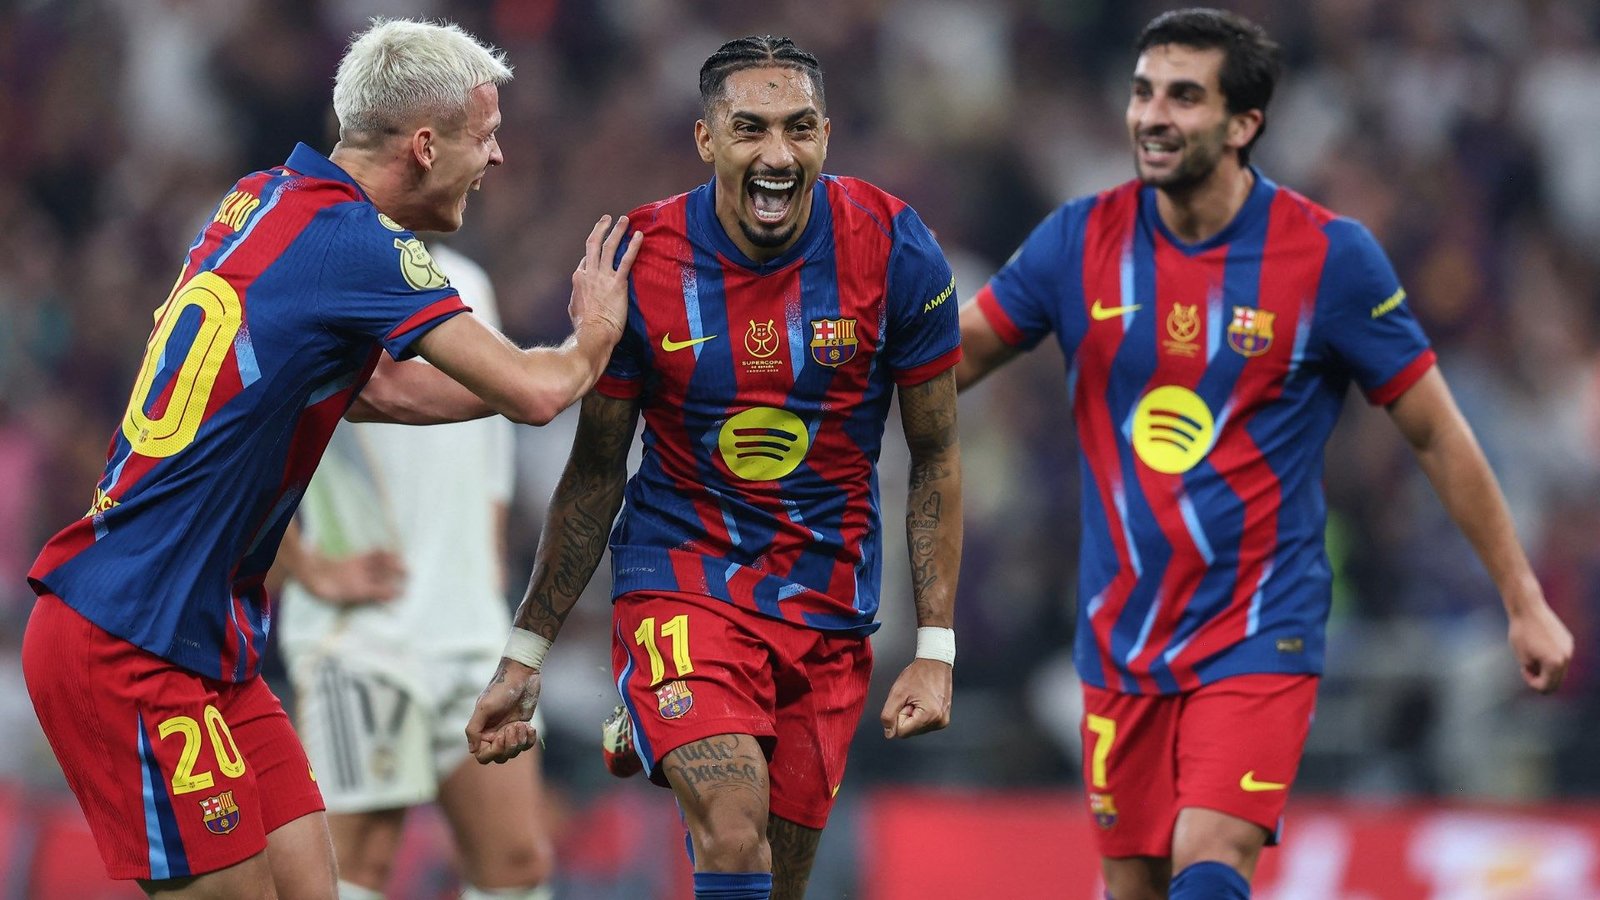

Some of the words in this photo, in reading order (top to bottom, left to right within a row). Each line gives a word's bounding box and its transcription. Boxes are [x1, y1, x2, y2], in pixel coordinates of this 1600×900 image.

[121, 263, 243, 458] 0
[634, 614, 695, 687] 11
[158, 704, 246, 795] 20
[1087, 712, 1117, 789] 7
